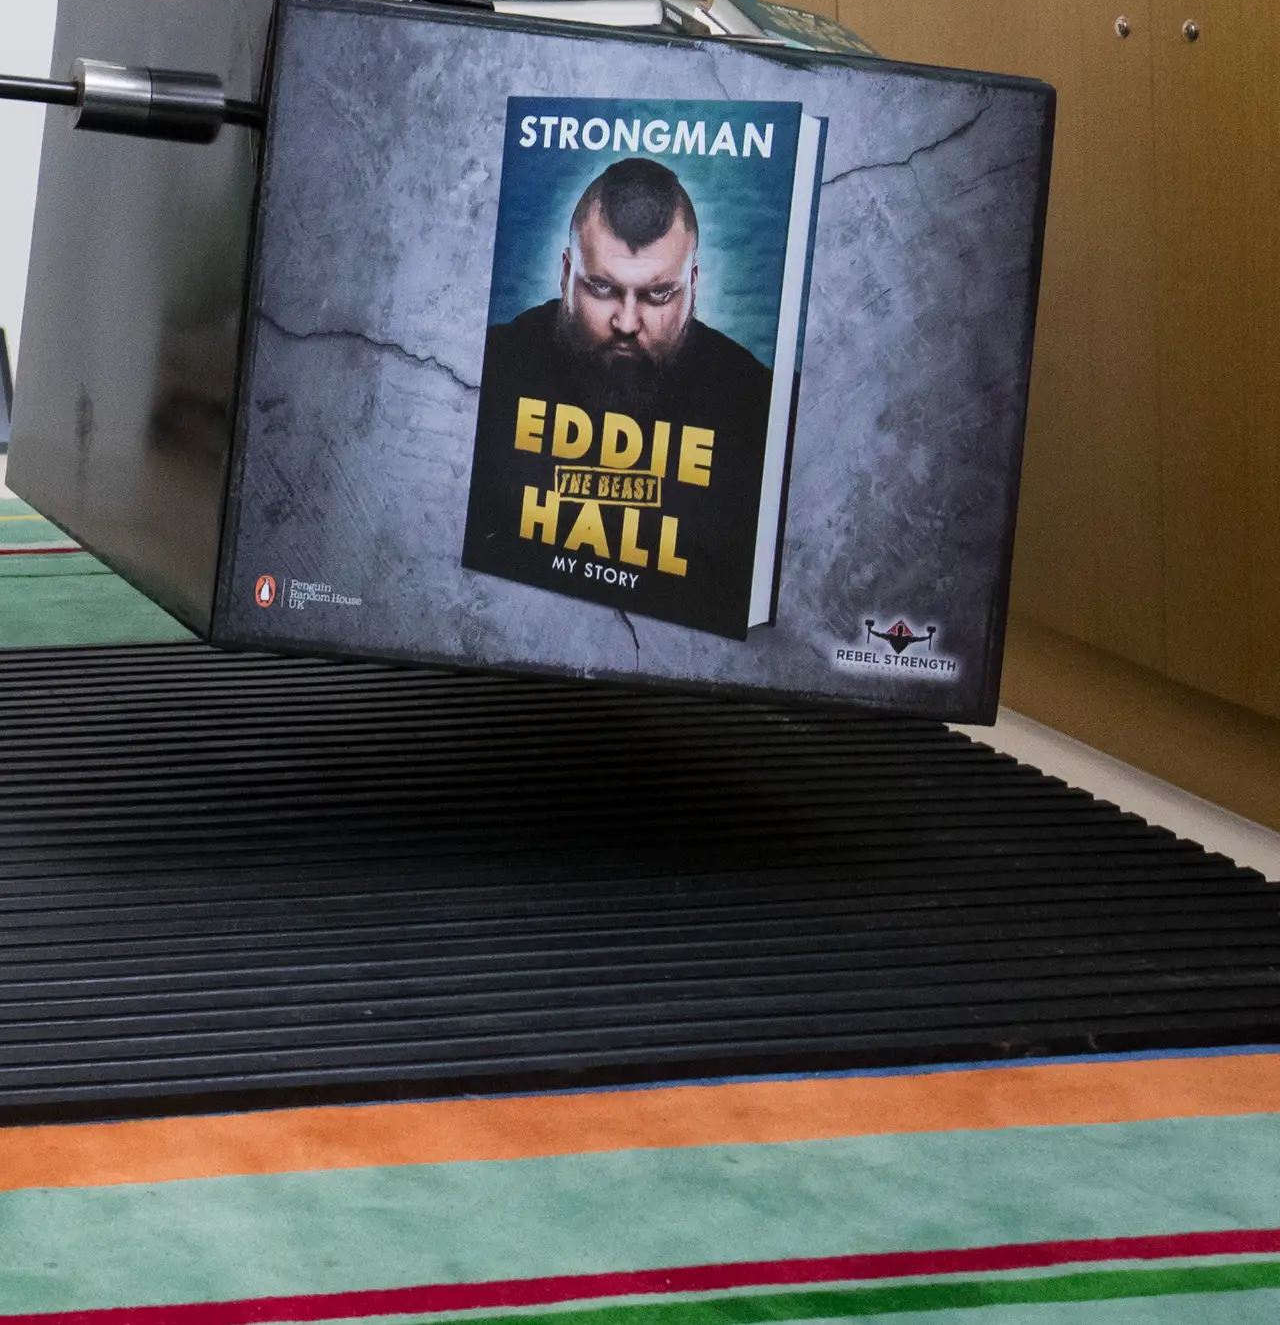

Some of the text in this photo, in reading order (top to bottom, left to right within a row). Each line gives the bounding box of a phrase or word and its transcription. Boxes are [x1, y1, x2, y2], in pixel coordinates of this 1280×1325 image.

[519, 115, 774, 159] STRONGMAN
[514, 396, 715, 487] EDDIE
[558, 473, 657, 501] THE BEAST
[519, 485, 688, 577] HALL
[290, 579, 332, 593] Penguin
[552, 556, 639, 589] MY STORY
[289, 589, 363, 606] Random House
[289, 600, 305, 610] UK
[836, 648, 880, 664] REBEL
[884, 653, 956, 672] STRENGTH
